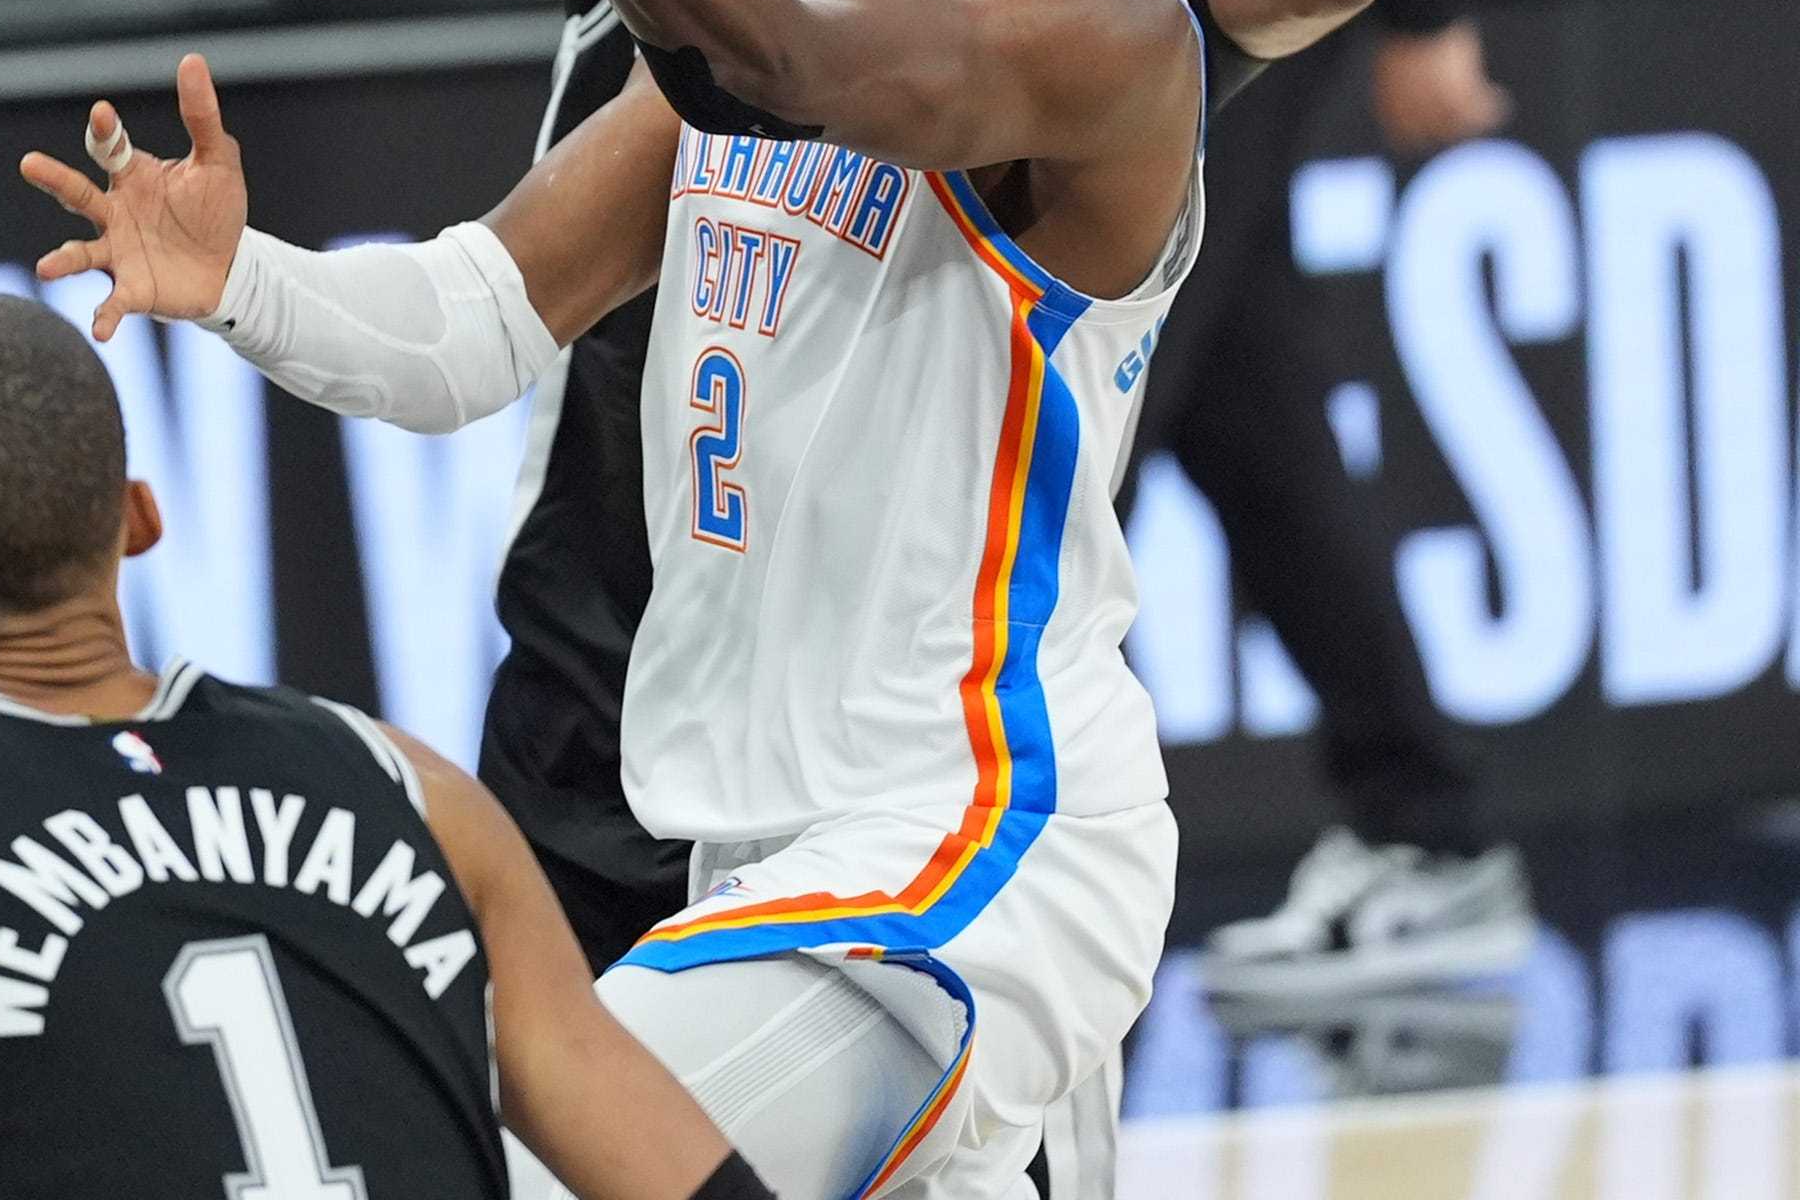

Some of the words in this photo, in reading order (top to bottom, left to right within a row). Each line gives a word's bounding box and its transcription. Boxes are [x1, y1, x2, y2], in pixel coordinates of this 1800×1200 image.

[672, 120, 910, 260] LAHOMA
[692, 216, 800, 337] CITY
[690, 347, 748, 554] 2
[161, 933, 367, 1200] 1
